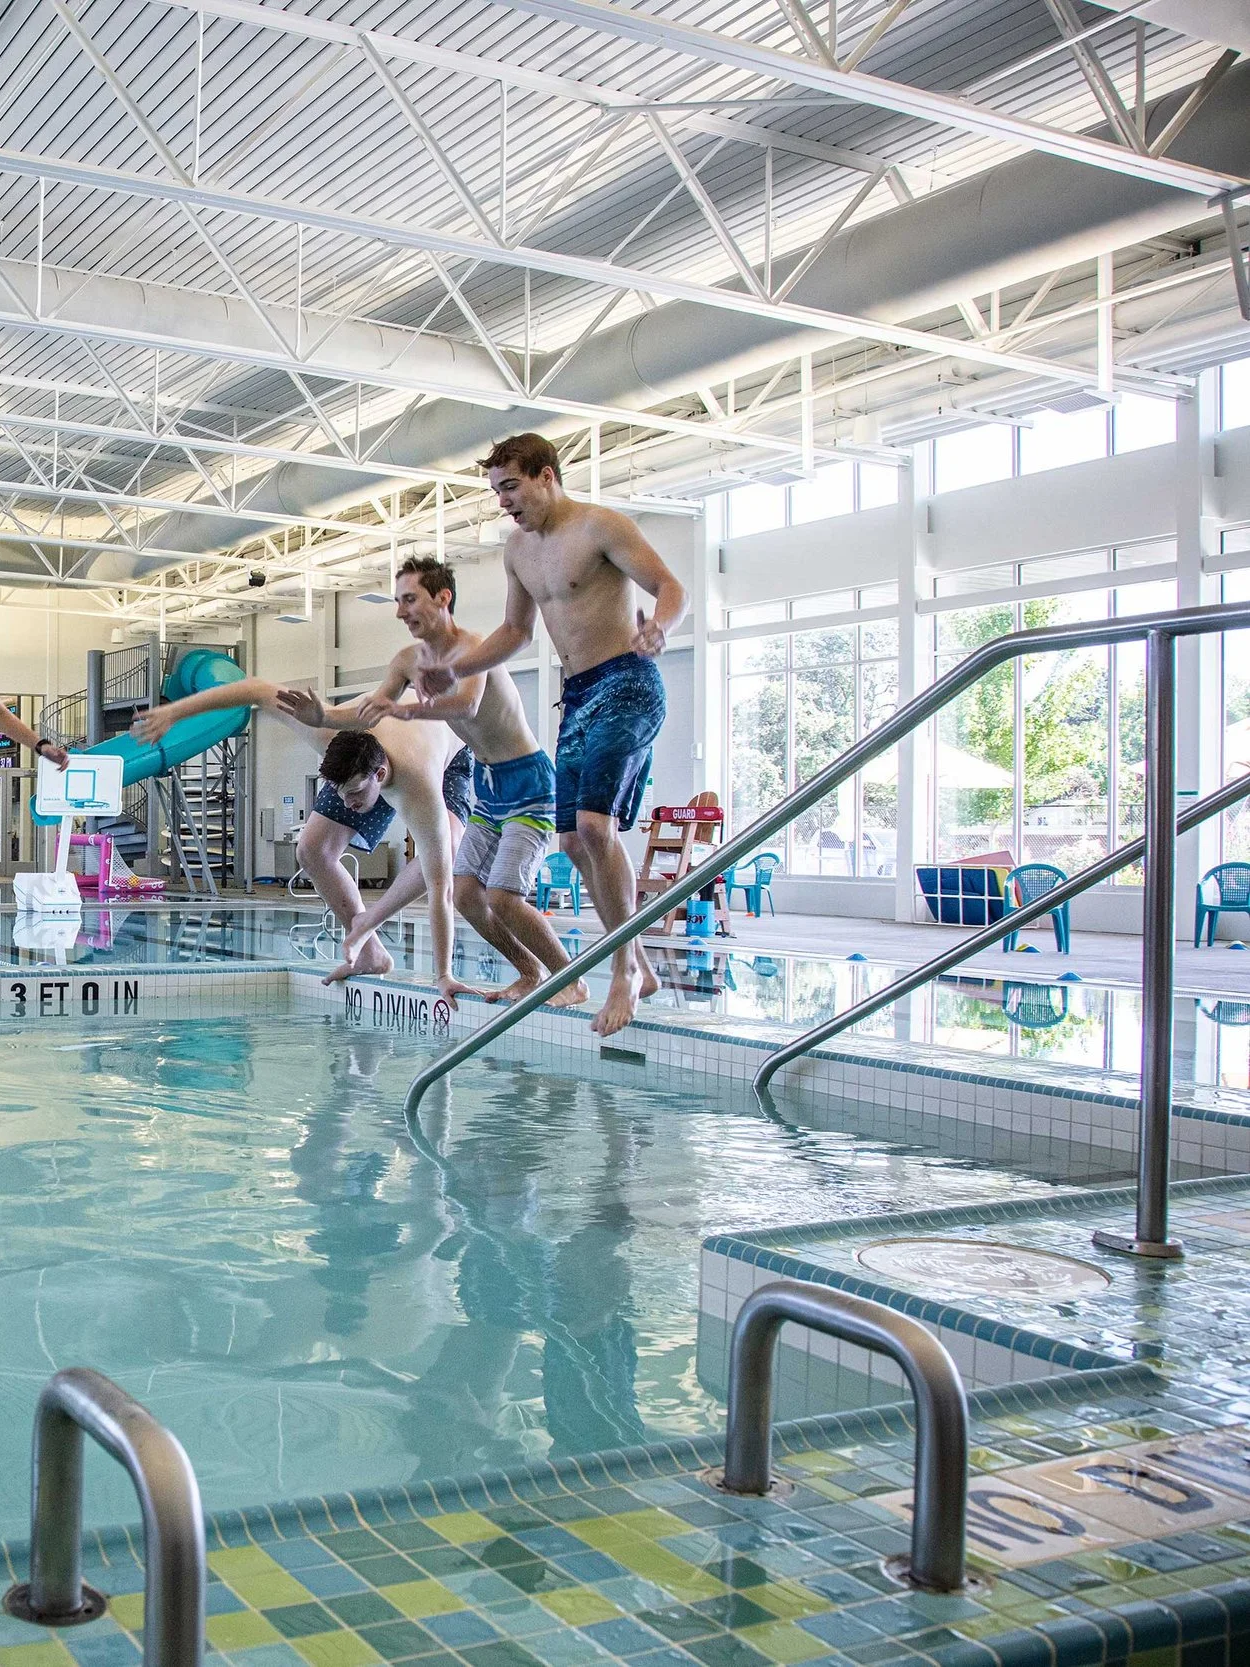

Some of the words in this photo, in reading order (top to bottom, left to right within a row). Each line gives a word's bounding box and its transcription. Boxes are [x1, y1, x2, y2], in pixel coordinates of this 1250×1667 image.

[672, 808, 696, 819] GUARD
[10, 982, 27, 1002] 3
[39, 982, 70, 1002] FT
[113, 980, 138, 1001] IN
[345, 986, 362, 1009] NO
[373, 991, 428, 1021] DIVING
